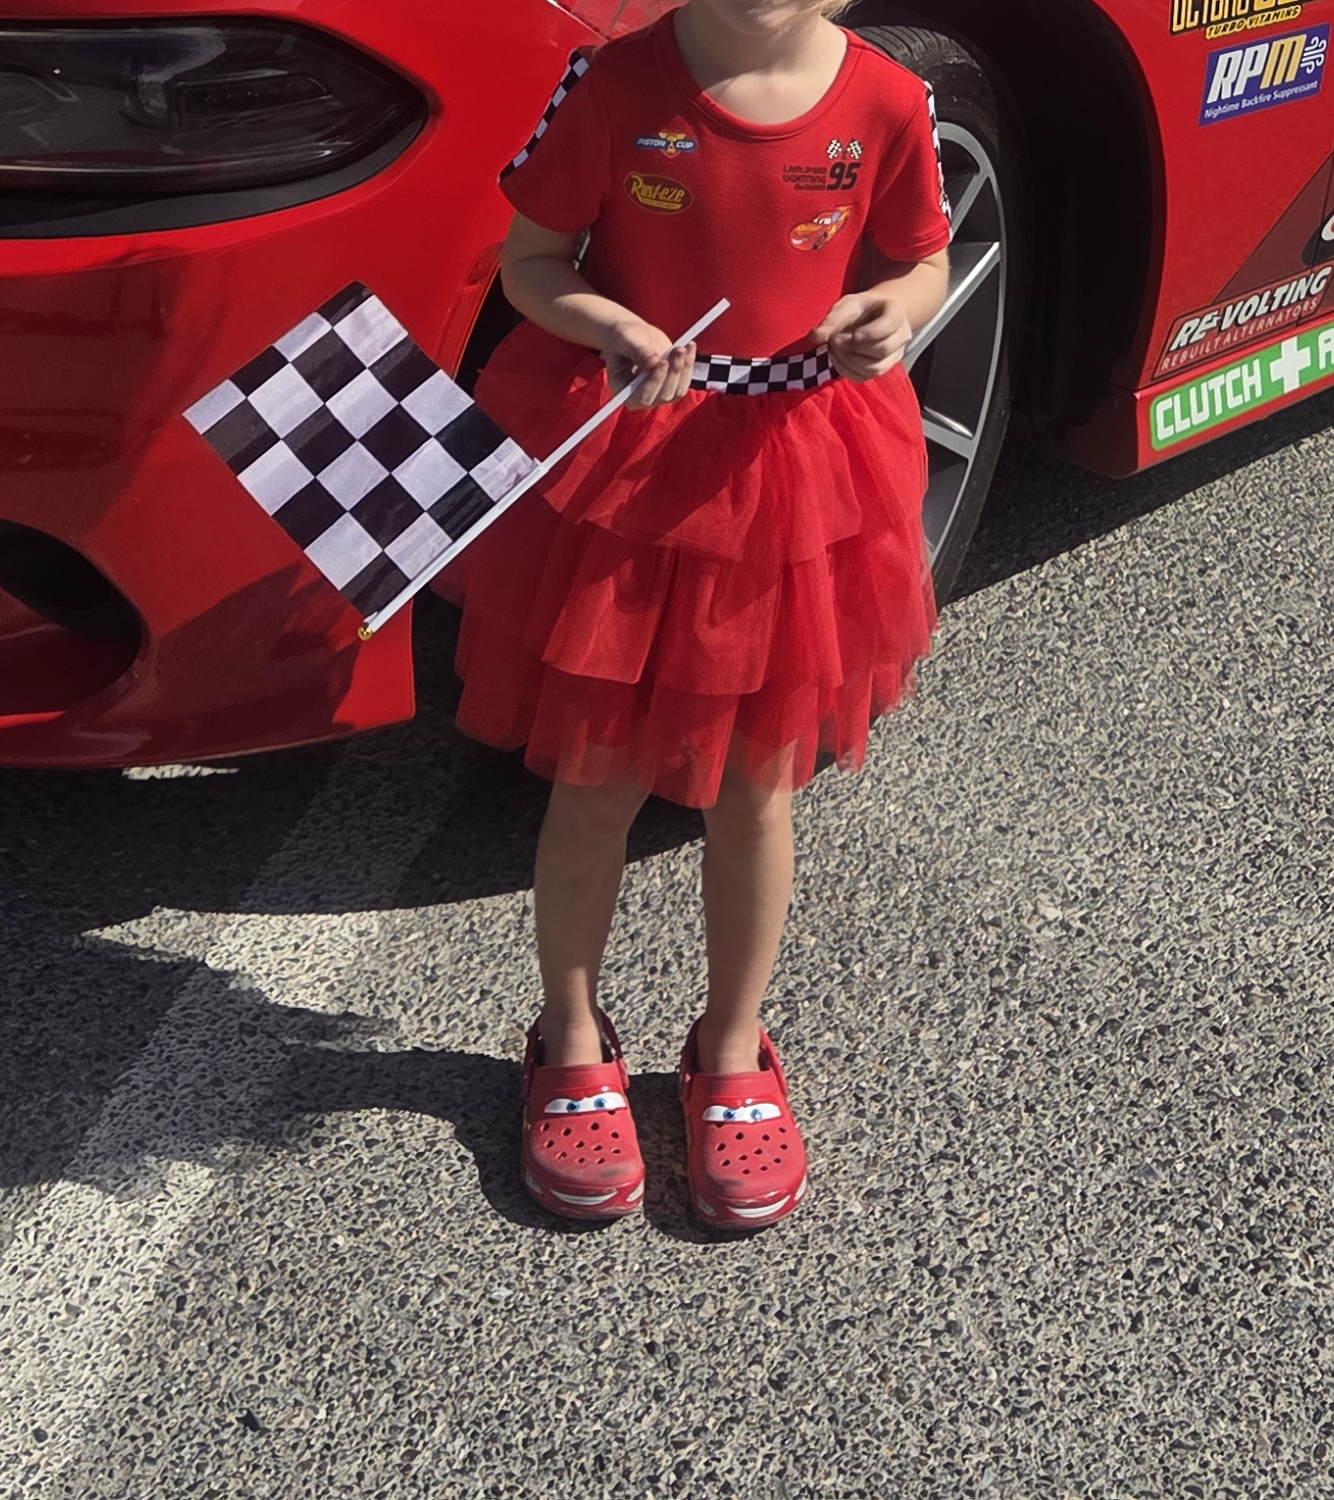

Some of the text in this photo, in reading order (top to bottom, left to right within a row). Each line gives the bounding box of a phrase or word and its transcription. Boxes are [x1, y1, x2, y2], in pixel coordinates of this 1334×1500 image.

[1207, 5, 1300, 37] TURBO VITAMINS
[1206, 34, 1307, 104] RPM
[1272, 80, 1318, 100] Suppressant
[637, 138, 694, 149] PISTON CUP
[630, 174, 685, 203] Rust-eze
[827, 161, 862, 190] 95
[1160, 298, 1318, 372] REBUILT ALTERNATORS
[1155, 358, 1262, 441] CLUTCH
